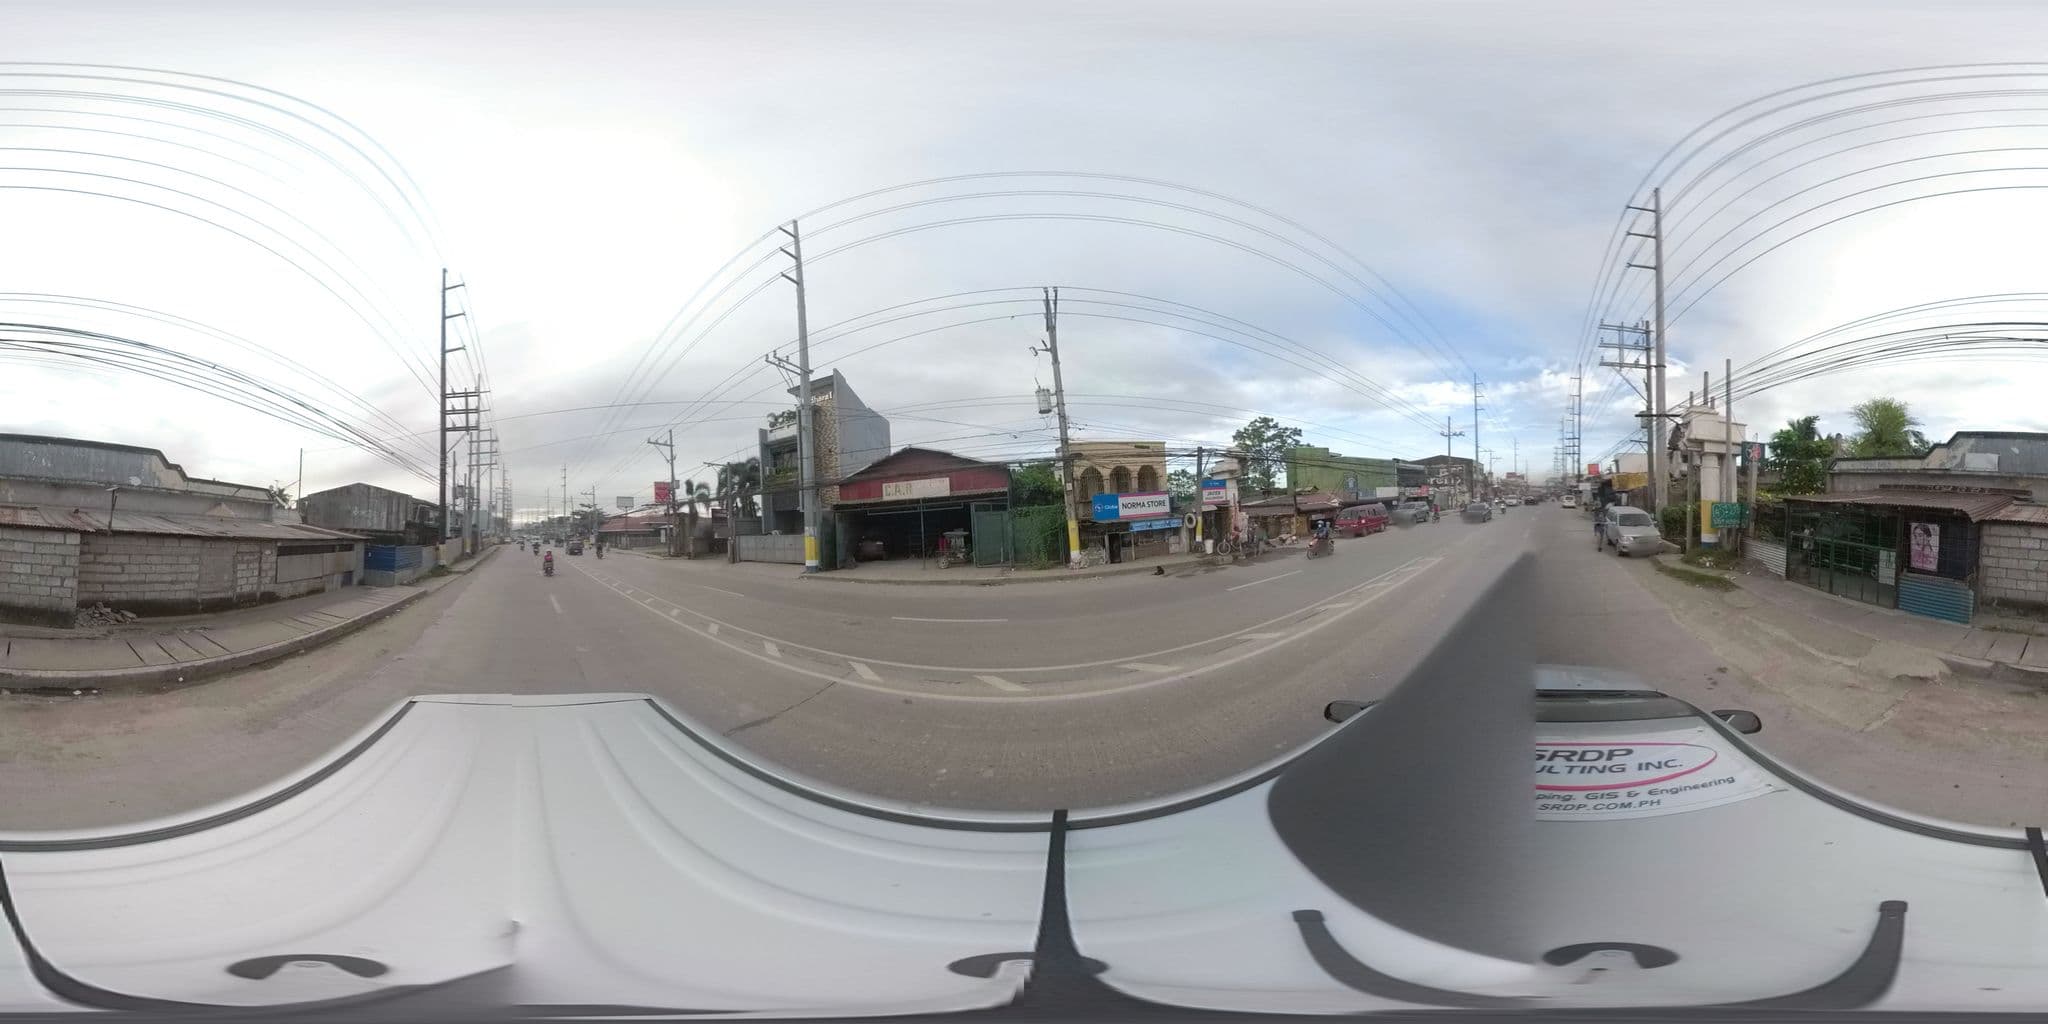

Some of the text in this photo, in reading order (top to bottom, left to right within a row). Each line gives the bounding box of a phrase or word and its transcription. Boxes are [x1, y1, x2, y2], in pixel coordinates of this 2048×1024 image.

[1122, 500, 1166, 510] NORMA STORE
[1638, 759, 1683, 771] INC.
[1585, 791, 1619, 800] GIS
[1626, 790, 1641, 798] &
[1647, 776, 1736, 796] Engineering
[1538, 799, 1661, 811] SRDP.COM.PH
